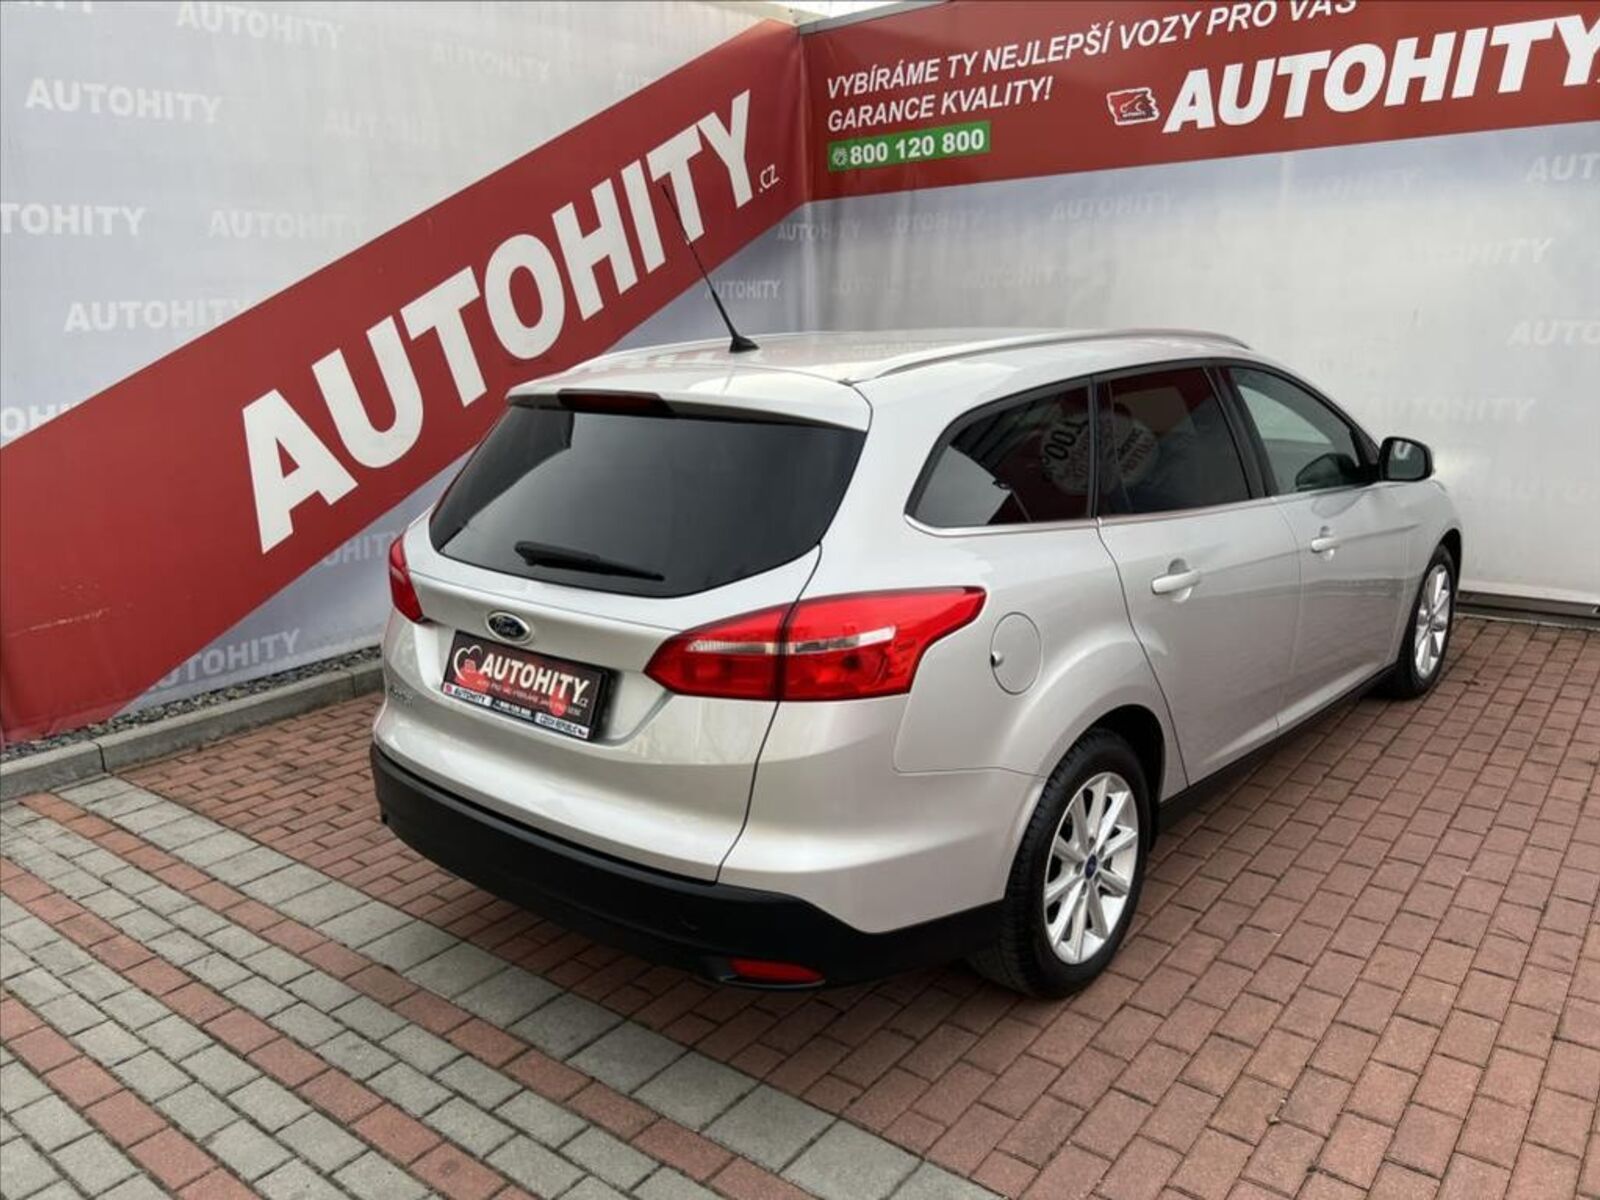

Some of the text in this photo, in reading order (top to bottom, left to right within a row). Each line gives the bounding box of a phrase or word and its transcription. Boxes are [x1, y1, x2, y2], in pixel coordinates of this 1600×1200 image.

[177, 2, 345, 49] AUTOHITY
[828, 58, 940, 99] VYBÍRÁME
[947, 51, 978, 79] TY
[983, 21, 1113, 73] NEJLEPŠÍ
[1120, 11, 1201, 50] VOZY
[1206, 0, 1276, 36] PRO
[1162, 14, 1600, 133] AUTOHITY
[25, 78, 222, 123] AUTOHITY
[828, 75, 1053, 132] GARANCE KVALITY!
[850, 128, 984, 165] 800 120 800
[208, 209, 367, 240] AUTOHITY
[242, 89, 752, 554] AUTOHITY
[480, 653, 590, 703] AUTOHITY
